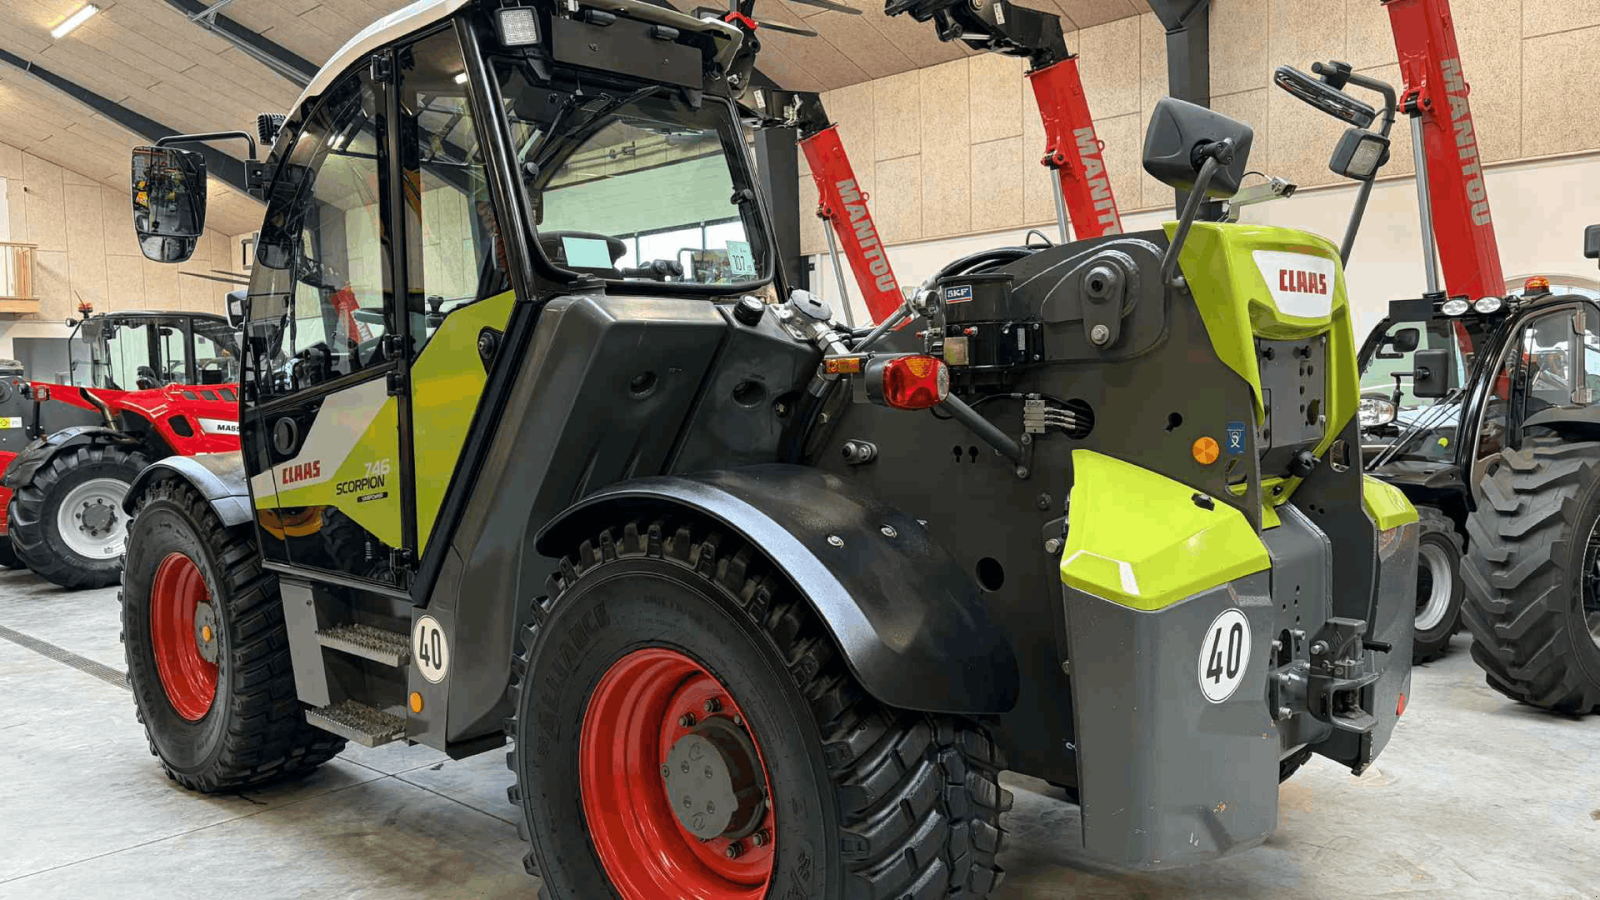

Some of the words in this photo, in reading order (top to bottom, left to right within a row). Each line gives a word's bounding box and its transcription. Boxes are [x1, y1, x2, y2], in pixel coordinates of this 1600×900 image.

[1440, 58, 1491, 226] MANITOU
[835, 178, 897, 292] MANITOU
[947, 287, 969, 298] SKF
[1279, 269, 1327, 295] CLAAS
[282, 460, 321, 484] CLAAS
[364, 459, 390, 478] 746
[336, 475, 385, 495] SCORPION
[420, 626, 442, 670] 40
[1206, 622, 1243, 684] 40
